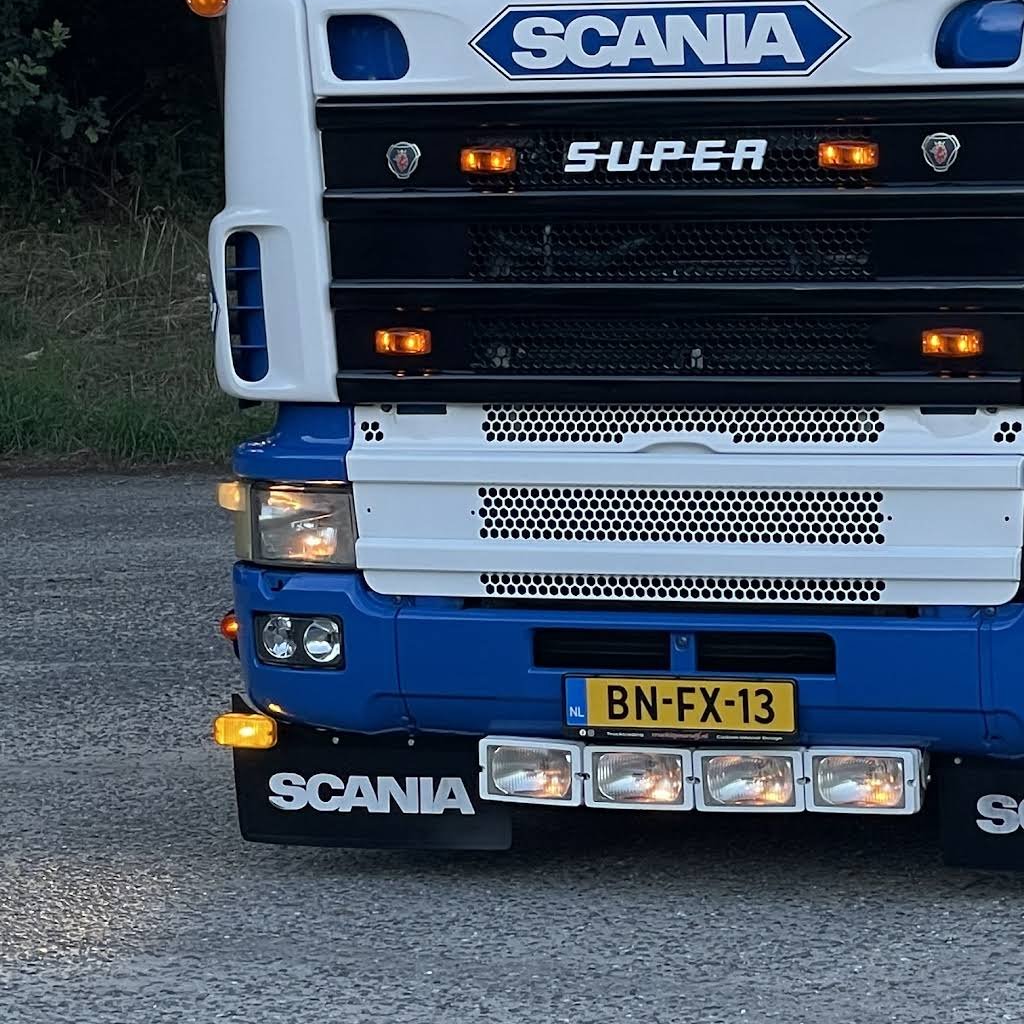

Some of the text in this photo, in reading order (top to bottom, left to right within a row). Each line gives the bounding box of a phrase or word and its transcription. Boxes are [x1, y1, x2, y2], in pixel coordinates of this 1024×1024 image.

[511, 12, 806, 70] SCANIA
[564, 139, 768, 173] SUPER
[569, 684, 775, 725] NL BN-FX-13
[268, 772, 476, 816] SCANIA
